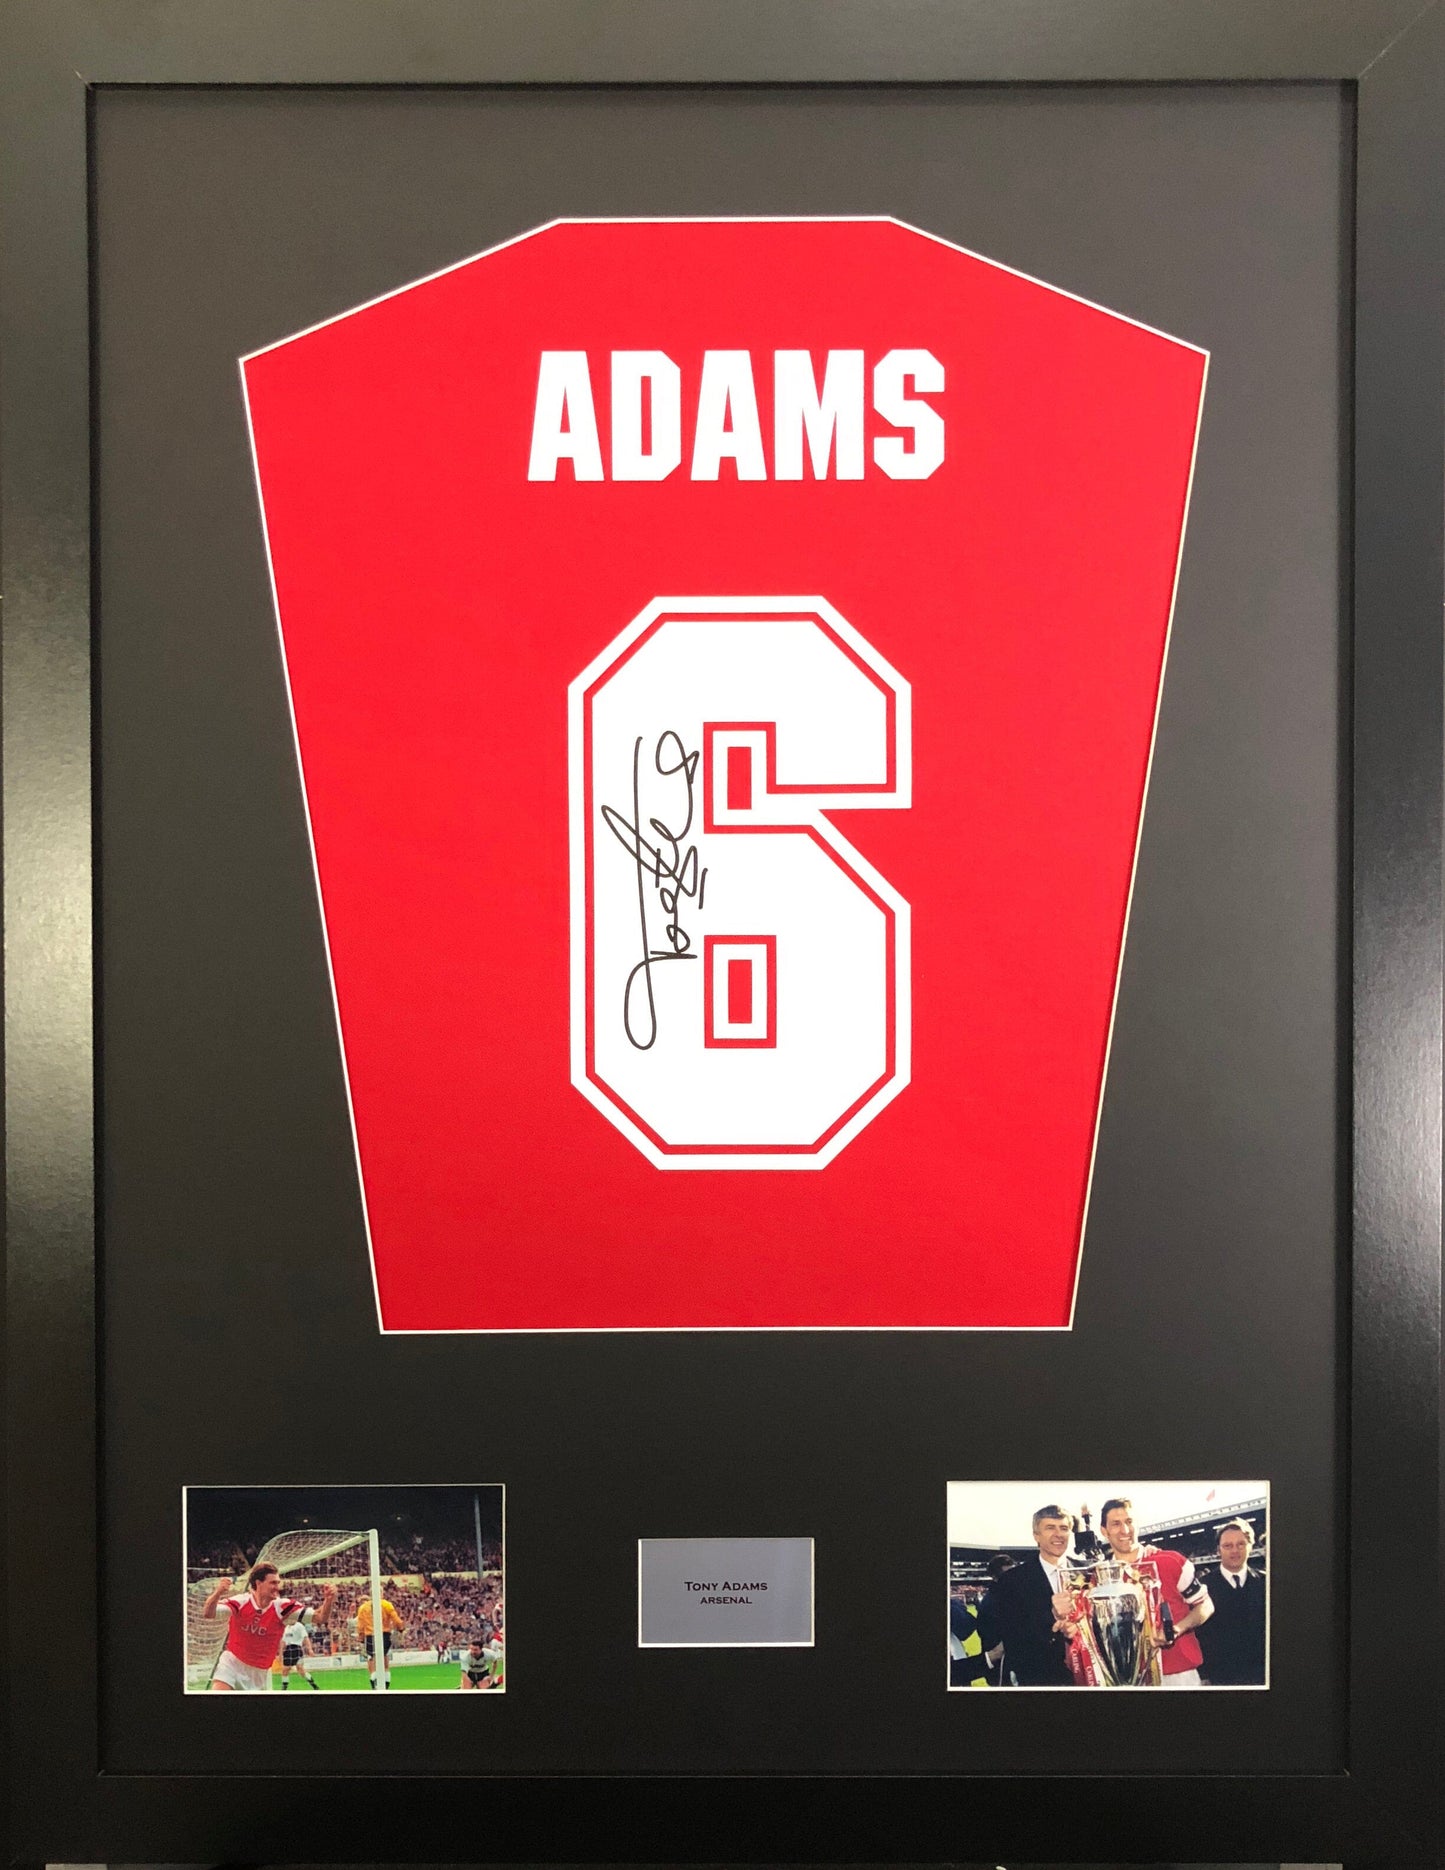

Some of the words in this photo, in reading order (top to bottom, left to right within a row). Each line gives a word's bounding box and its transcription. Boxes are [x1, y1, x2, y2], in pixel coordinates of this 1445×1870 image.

[527, 349, 946, 482] ADAMS
[567, 595, 913, 1171] 6
[241, 1623, 268, 1636] JVC
[699, 1596, 753, 1605] ARSENAL
